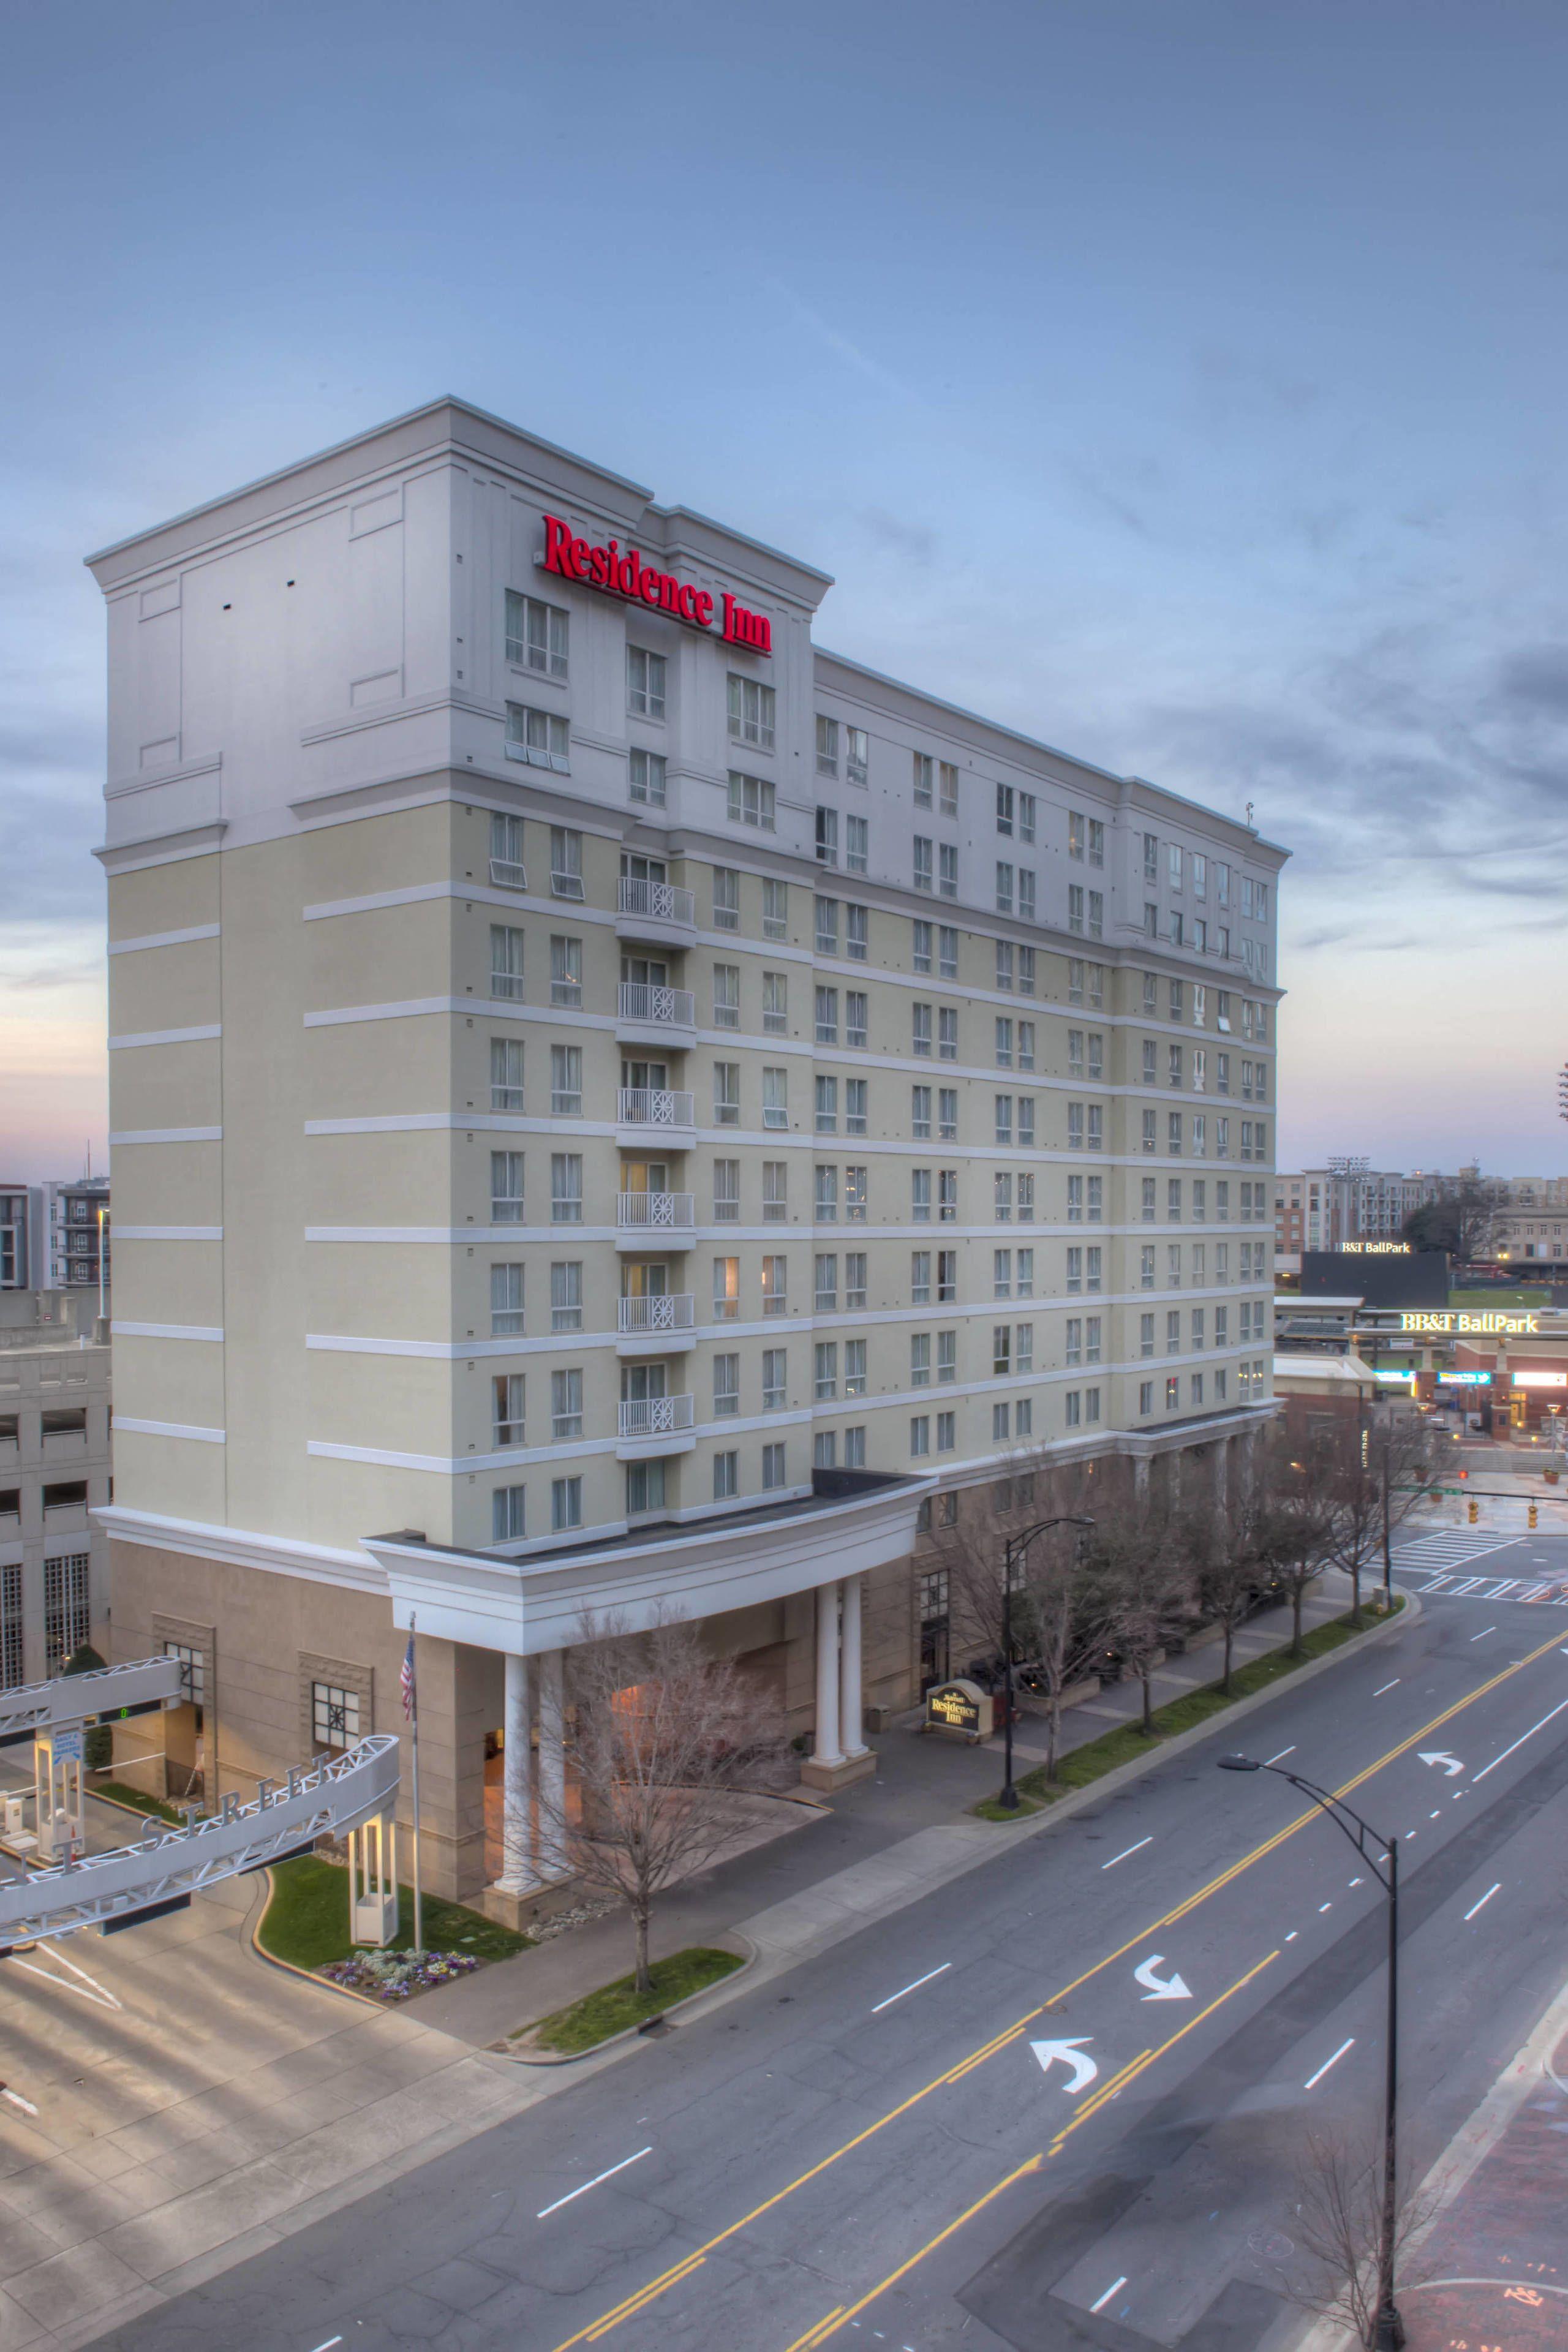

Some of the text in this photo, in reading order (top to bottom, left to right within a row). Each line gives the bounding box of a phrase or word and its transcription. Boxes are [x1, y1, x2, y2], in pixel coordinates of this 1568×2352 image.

[543, 515, 772, 652] Residence Inn
[1366, 1242, 1411, 1253] BallPark
[1400, 1314, 1538, 1332] BB&T BallPark
[932, 1698, 976, 1716] Residence
[946, 1711, 963, 1724] Inn
[141, 1751, 331, 1849] STREET
